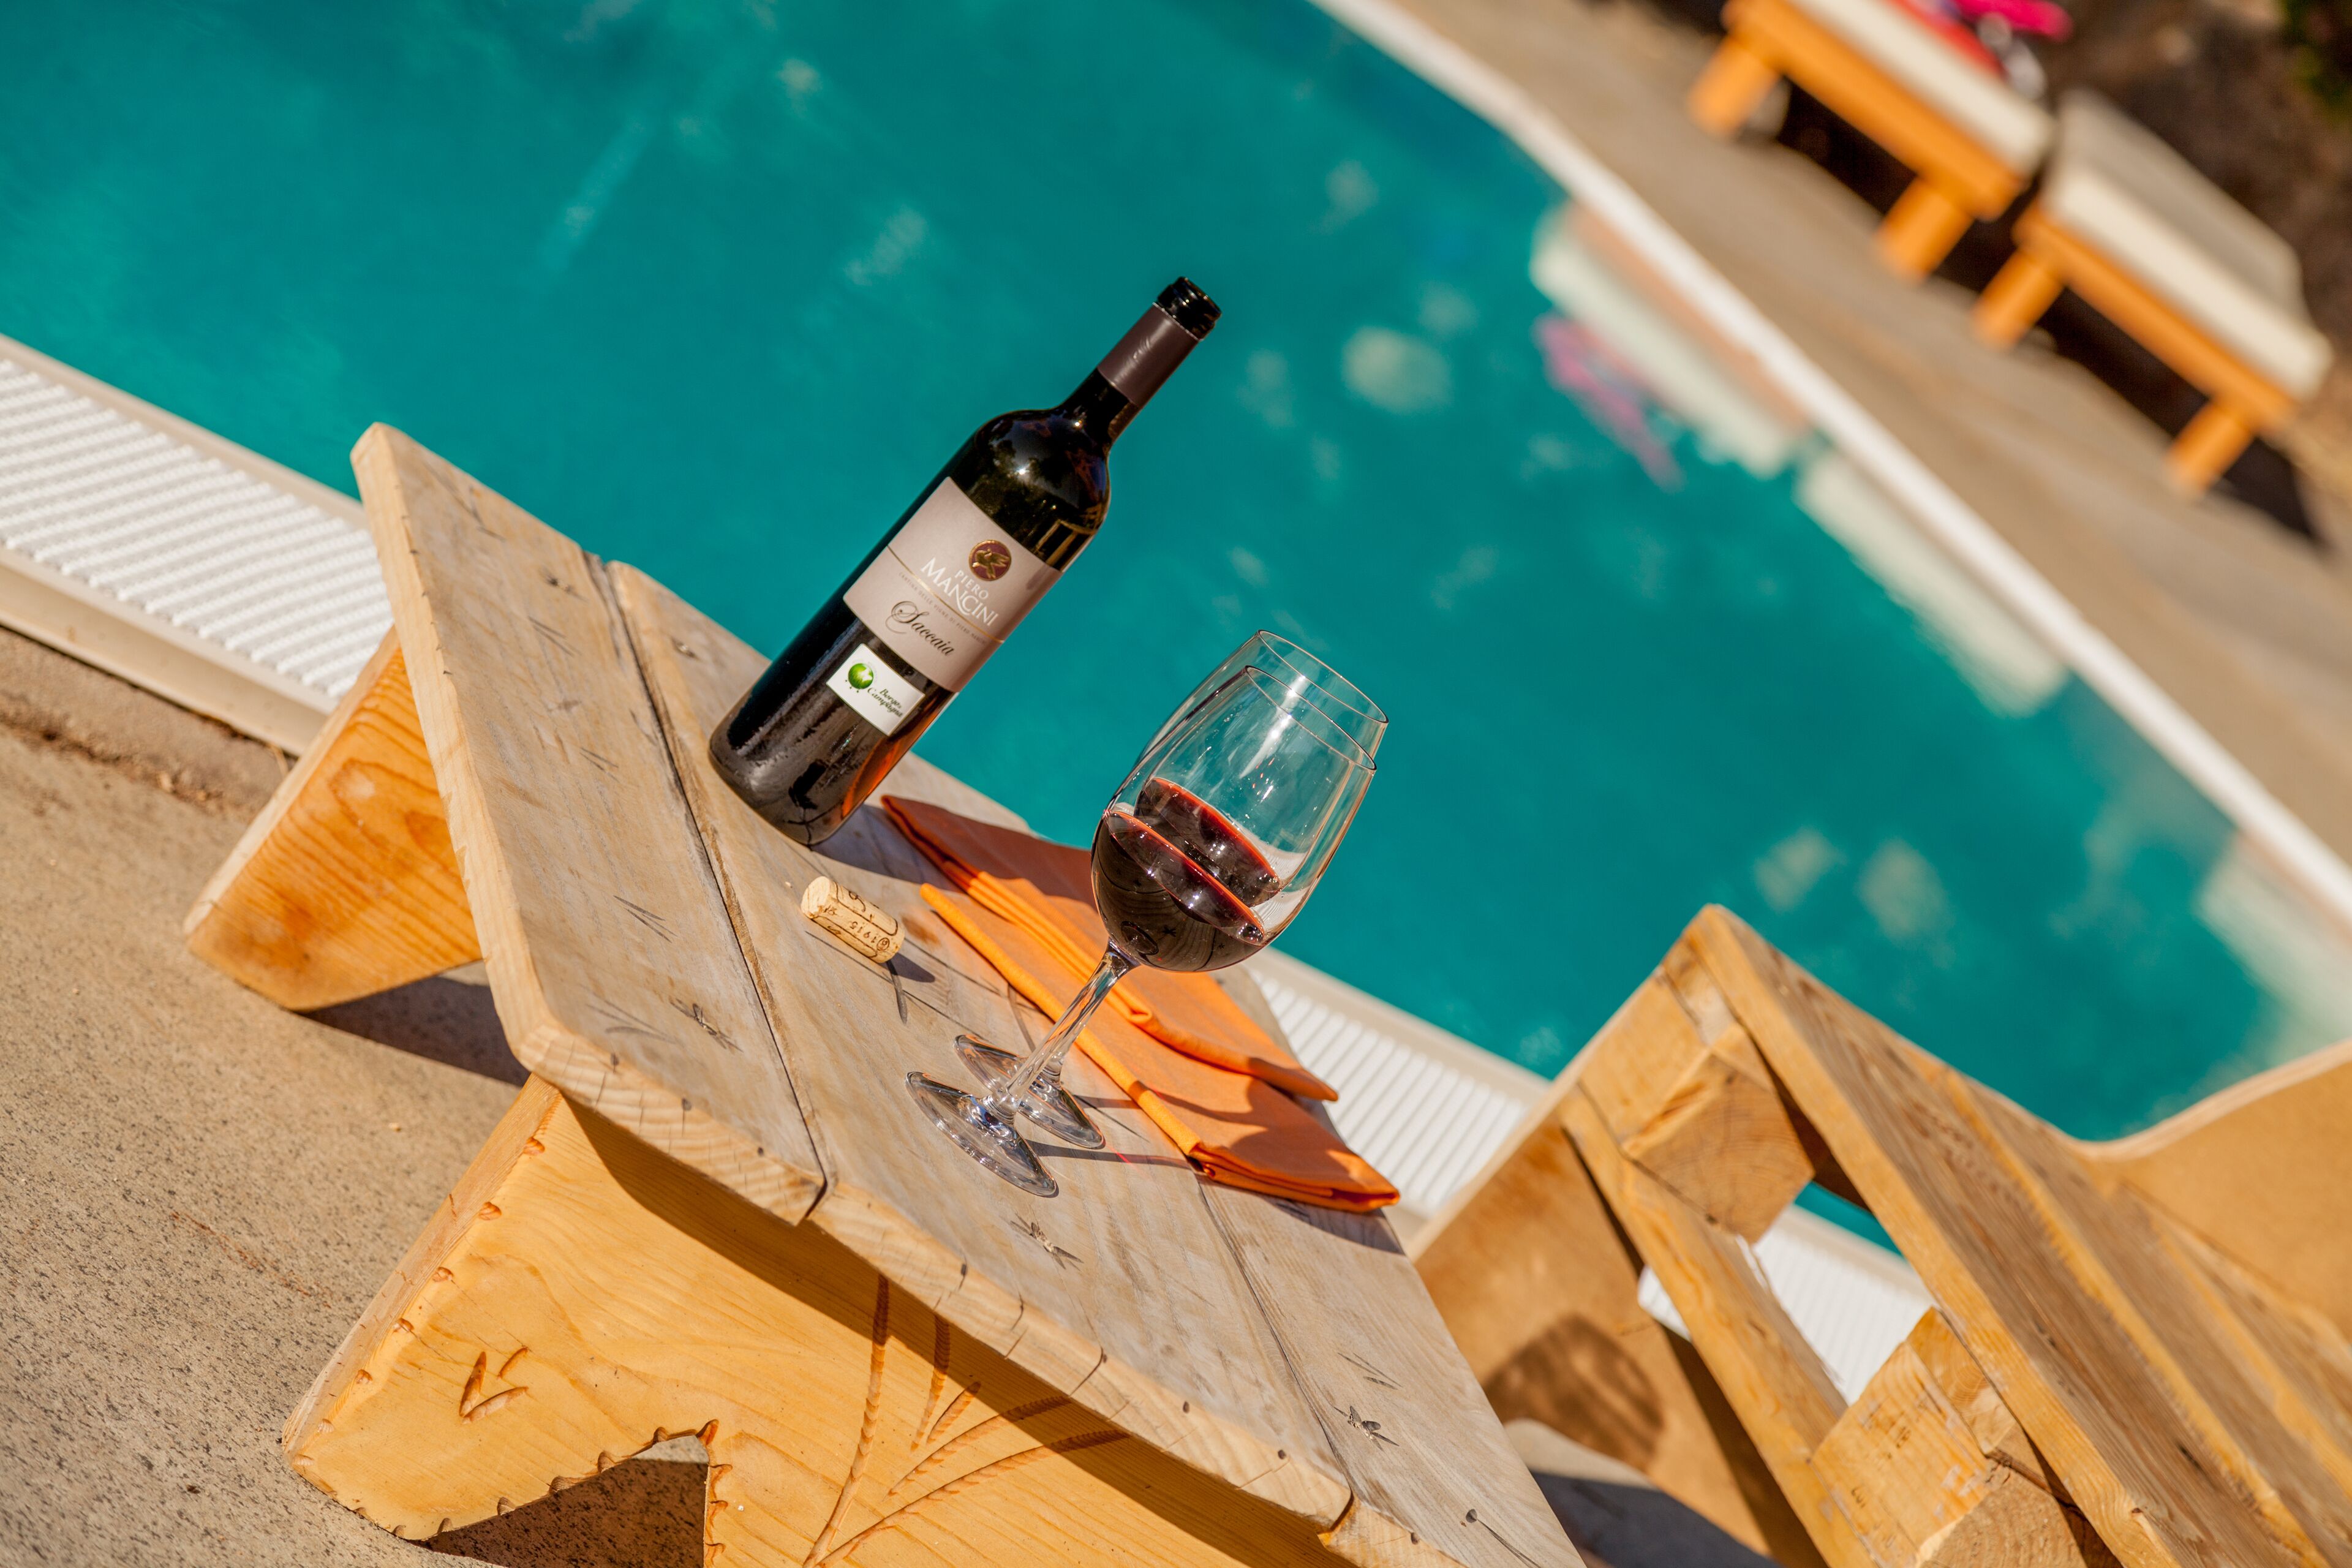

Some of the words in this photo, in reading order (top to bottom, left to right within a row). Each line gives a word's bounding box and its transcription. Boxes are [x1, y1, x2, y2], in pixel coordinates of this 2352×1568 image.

[921, 557, 998, 626] MANCINI
[955, 570, 989, 599] PIERO
[886, 601, 954, 657] Saccaia
[867, 688, 903, 717] Campagna
